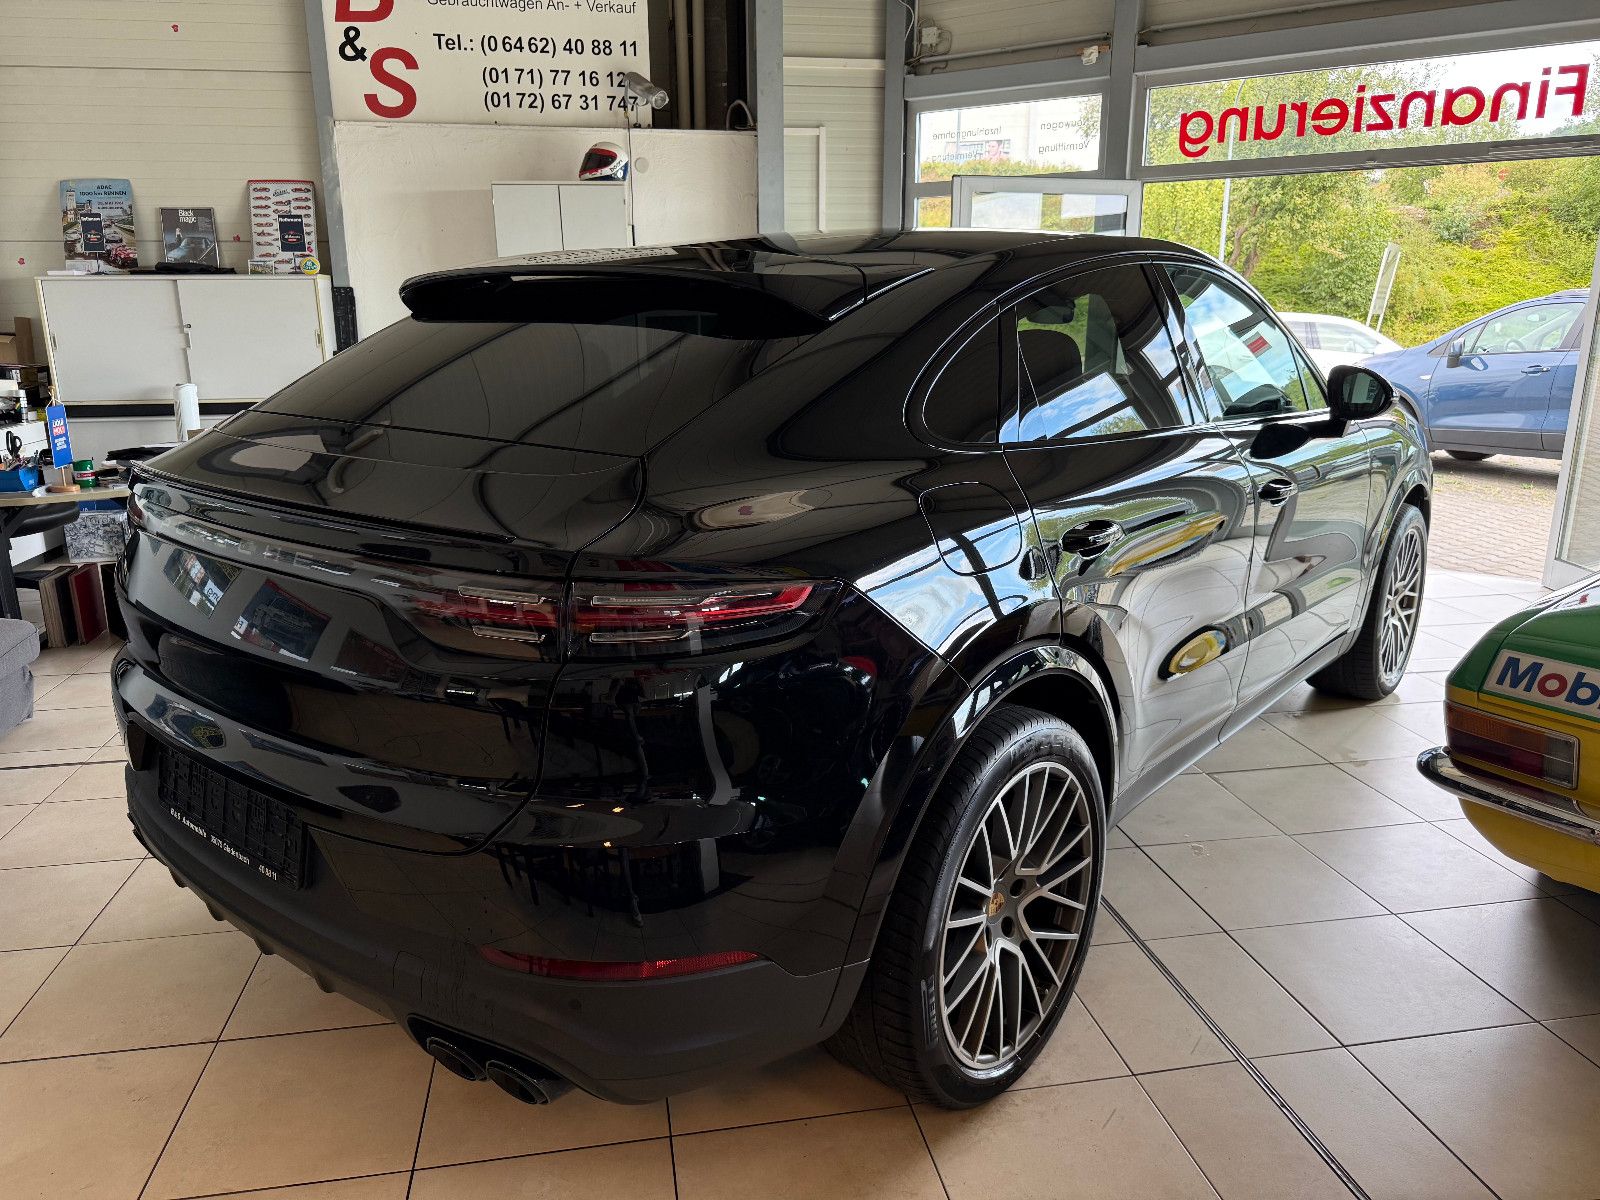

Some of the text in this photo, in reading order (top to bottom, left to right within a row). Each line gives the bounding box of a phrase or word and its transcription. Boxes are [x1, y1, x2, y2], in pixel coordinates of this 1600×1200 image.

[586, 0, 637, 14] Verkauf
[338, 25, 367, 62] &
[433, 33, 474, 52] Tel.:
[563, 38, 585, 55] 40
[591, 40, 613, 56] 88
[619, 41, 637, 56] 11
[364, 47, 419, 119] S
[550, 69, 571, 86] 77
[578, 70, 600, 87] 16
[551, 94, 572, 110] 67
[579, 94, 599, 111] 31
[178, 209, 194, 217] Black
[179, 216, 197, 224] magic
[1495, 656, 1600, 709] Mob
